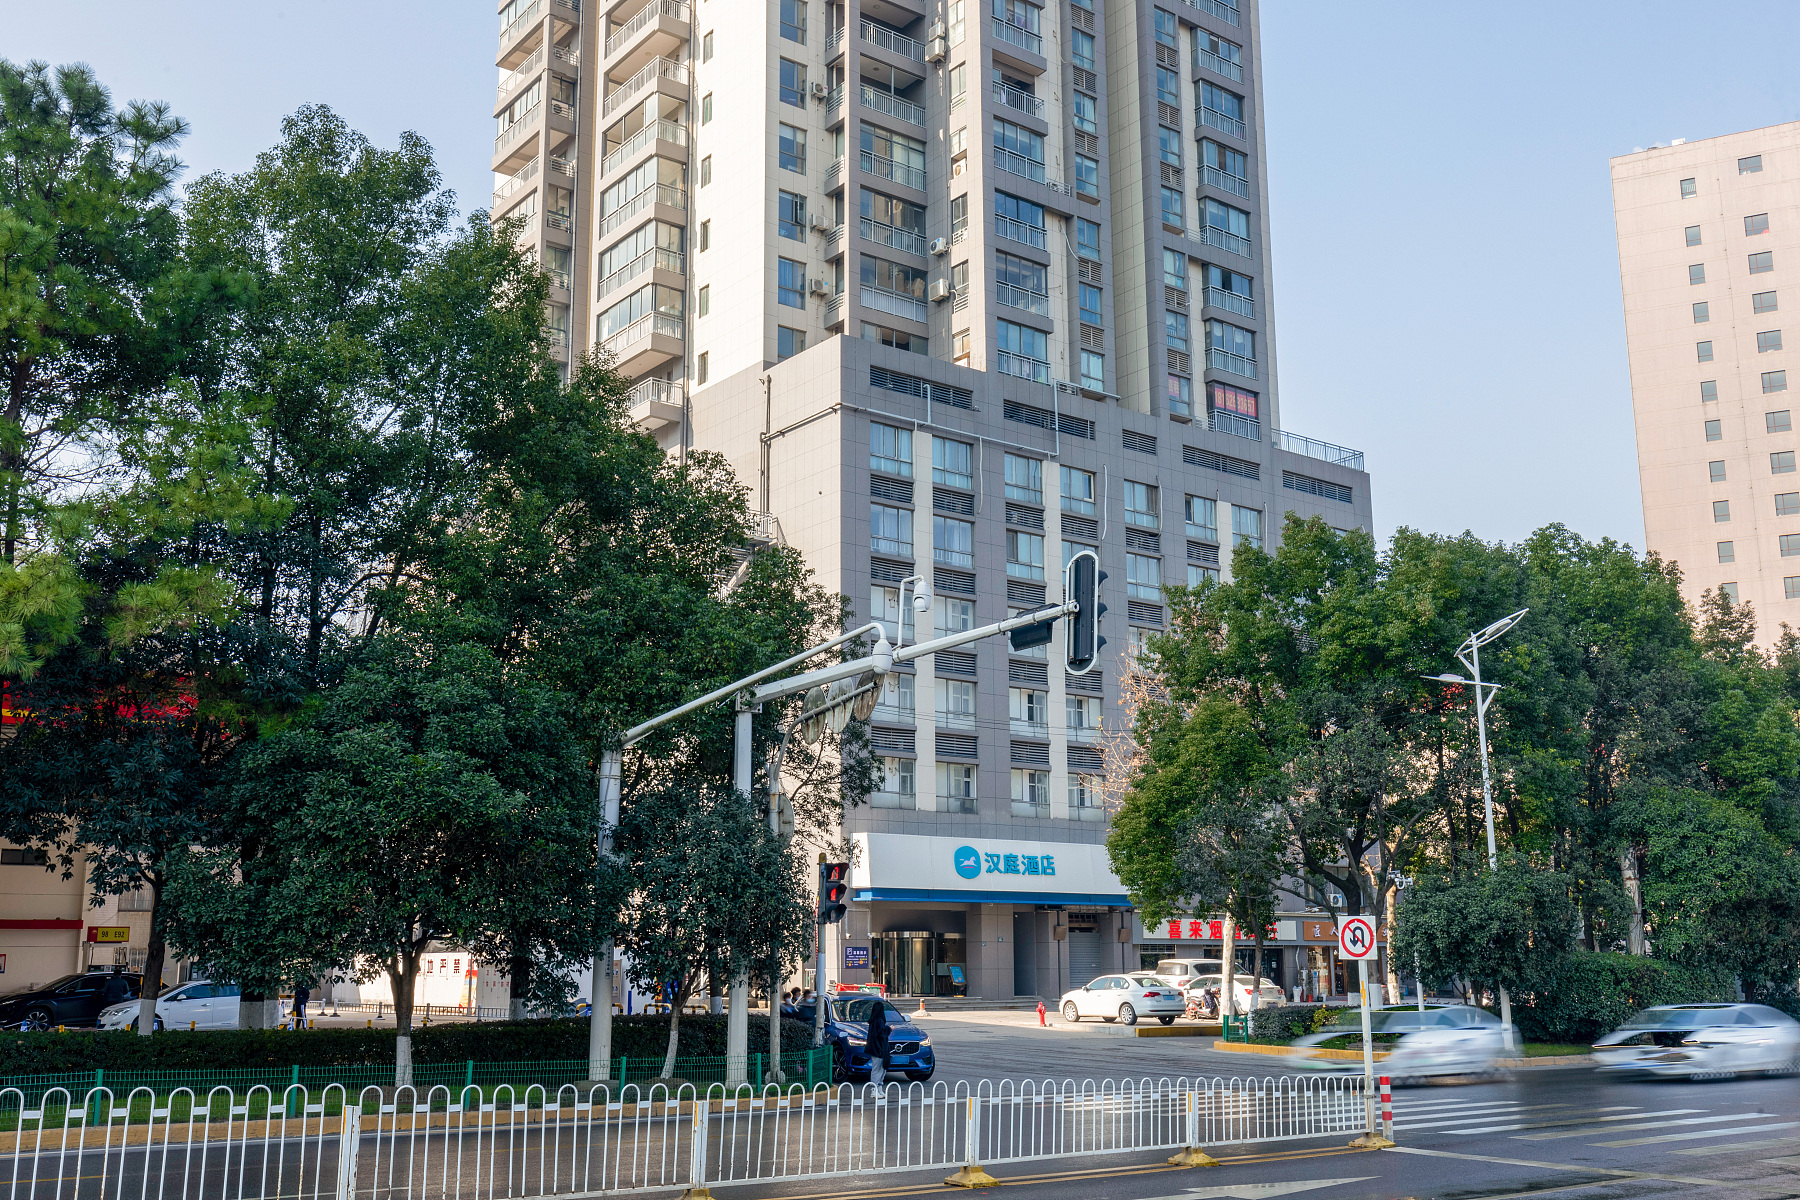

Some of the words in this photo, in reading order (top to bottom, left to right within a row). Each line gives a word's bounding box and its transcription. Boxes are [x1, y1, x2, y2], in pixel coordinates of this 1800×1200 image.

[984, 852, 1056, 876] 汉庭酒店
[101, 930, 109, 938] 98
